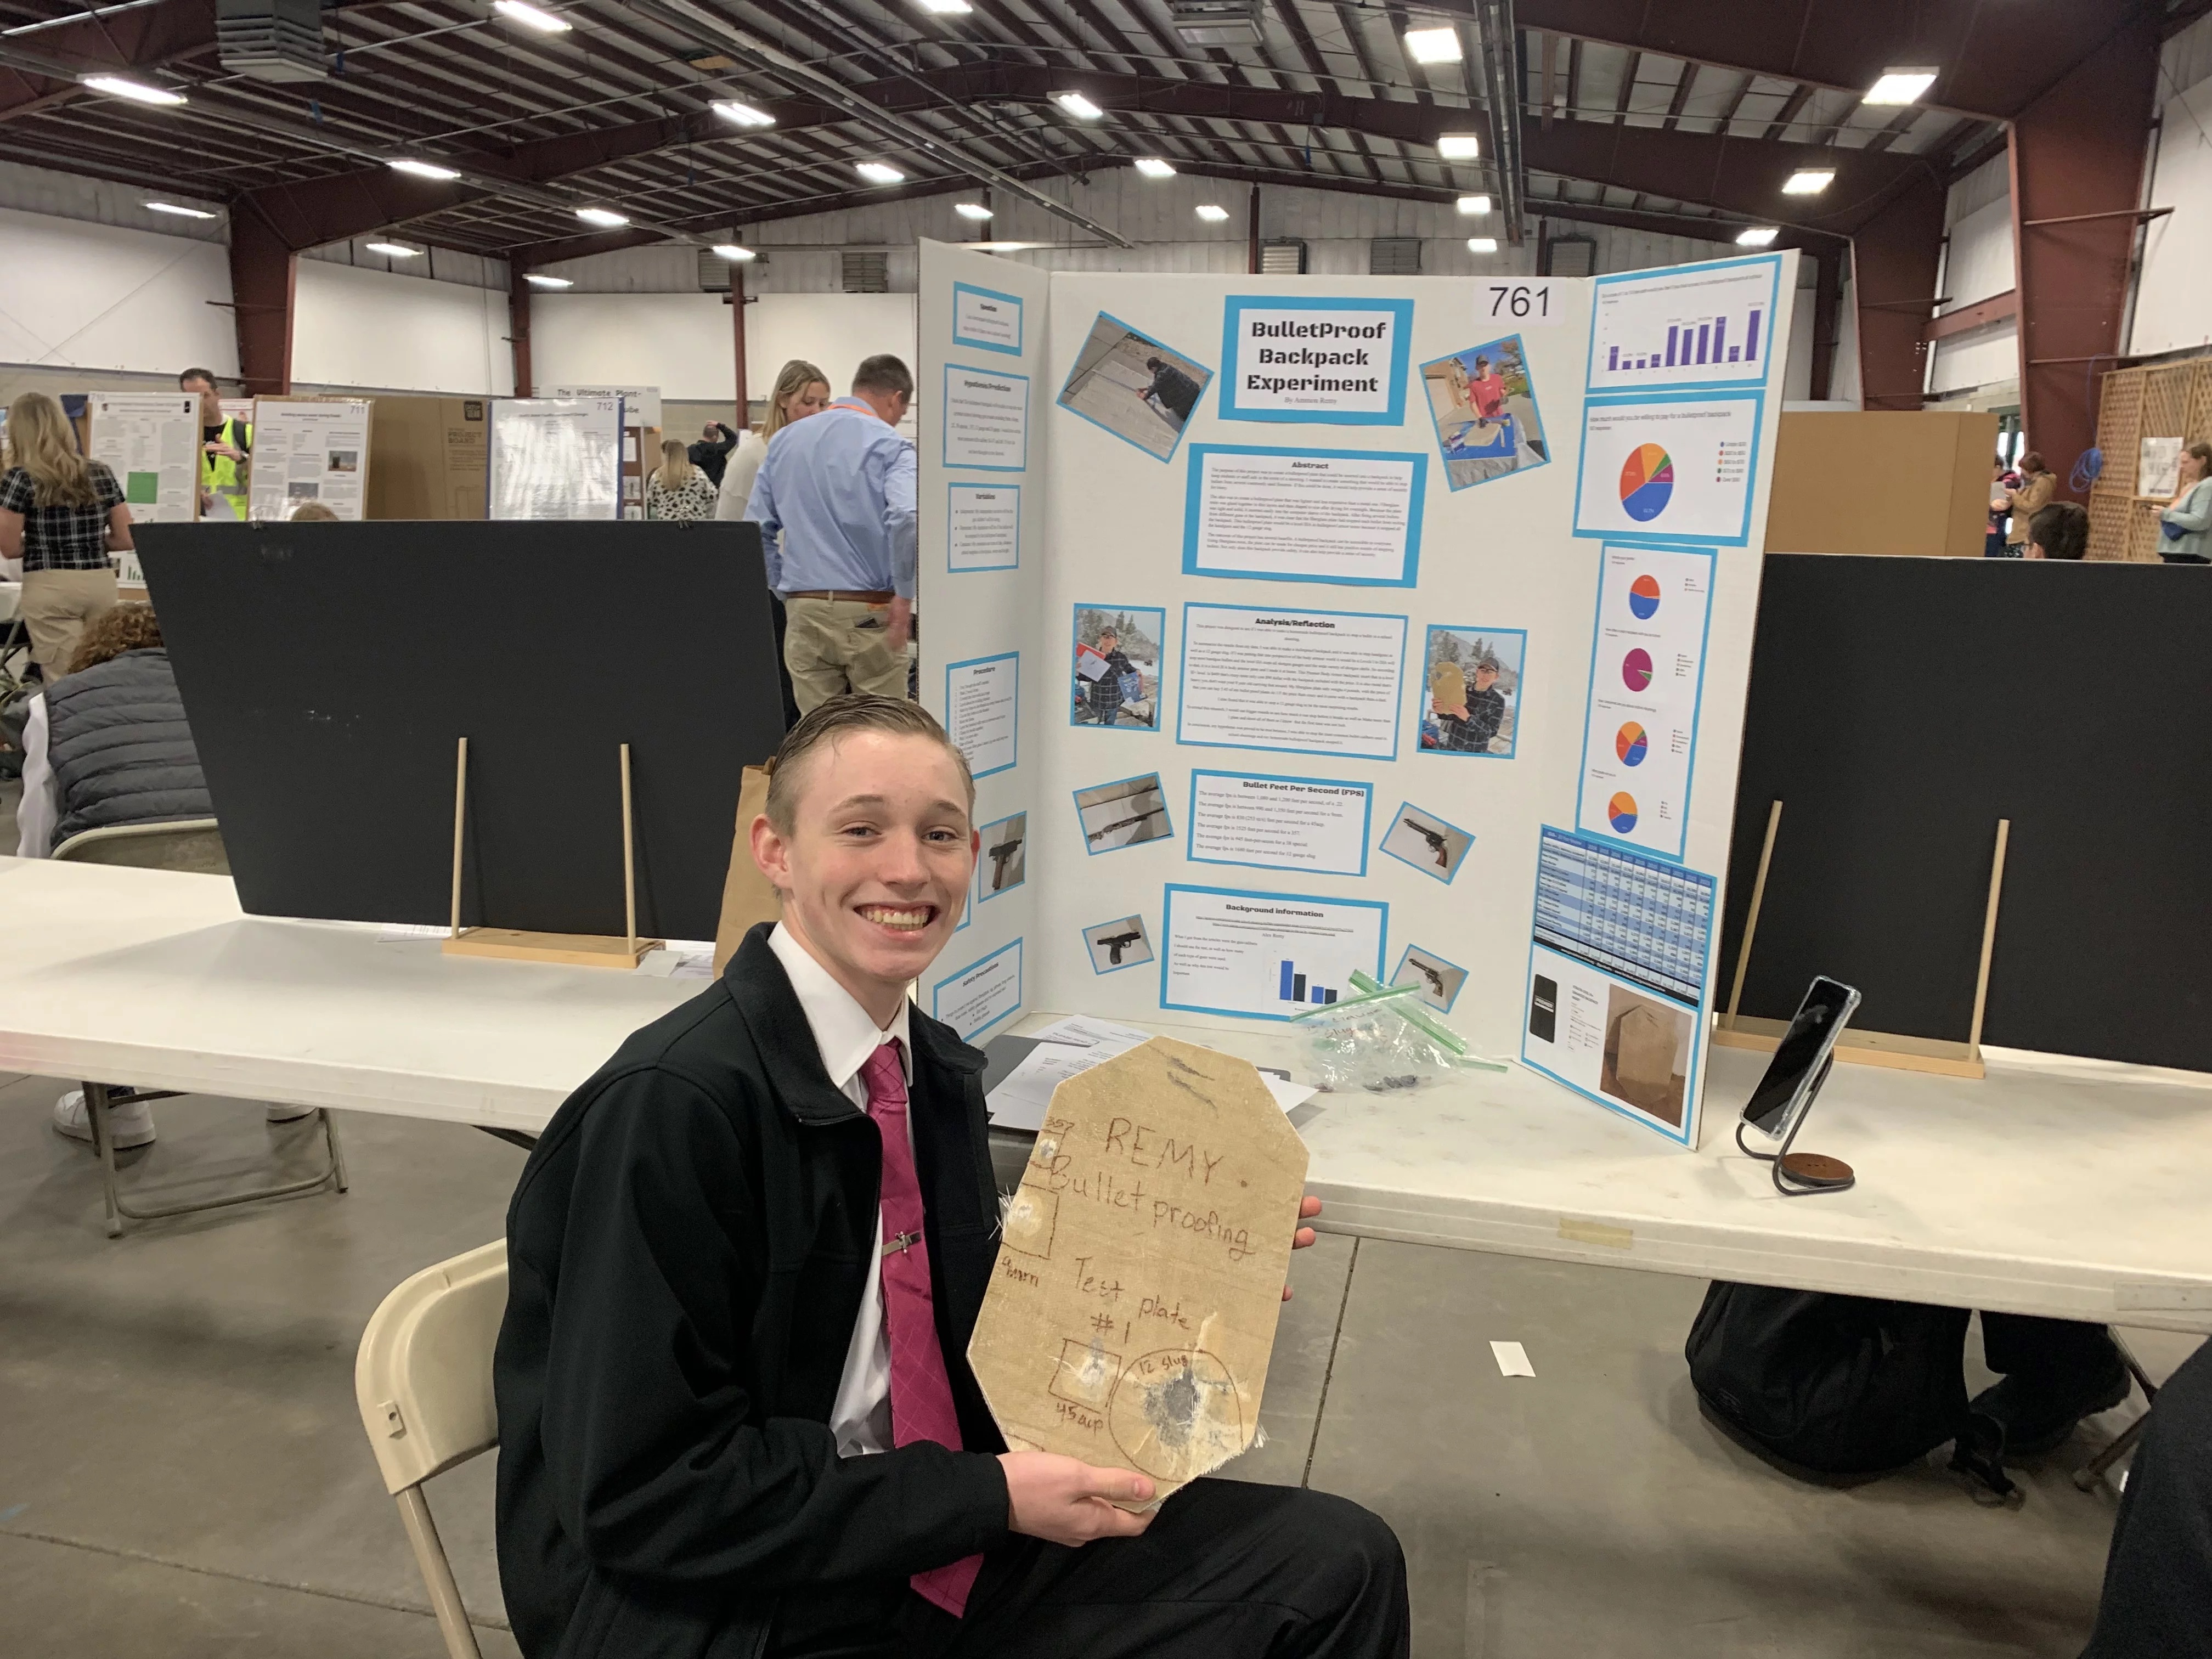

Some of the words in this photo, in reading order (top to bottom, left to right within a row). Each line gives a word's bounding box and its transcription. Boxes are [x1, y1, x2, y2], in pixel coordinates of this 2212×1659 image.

[1489, 286, 1549, 317] 761
[1251, 320, 1387, 339] BulletProof
[1259, 347, 1369, 368] Backpack
[1246, 374, 1379, 394] Experiment
[349, 405, 365, 414] 711
[596, 402, 614, 411] 712
[1255, 617, 1335, 629] Analysis/Reflection
[1307, 786, 1339, 794] Second
[1226, 904, 1274, 914] Background
[1276, 907, 1324, 918] information
[1105, 1118, 1224, 1186] REMY
[1048, 1154, 1146, 1210] Bullet
[1153, 1200, 1256, 1261] proofing
[1075, 1256, 1125, 1301] Test
